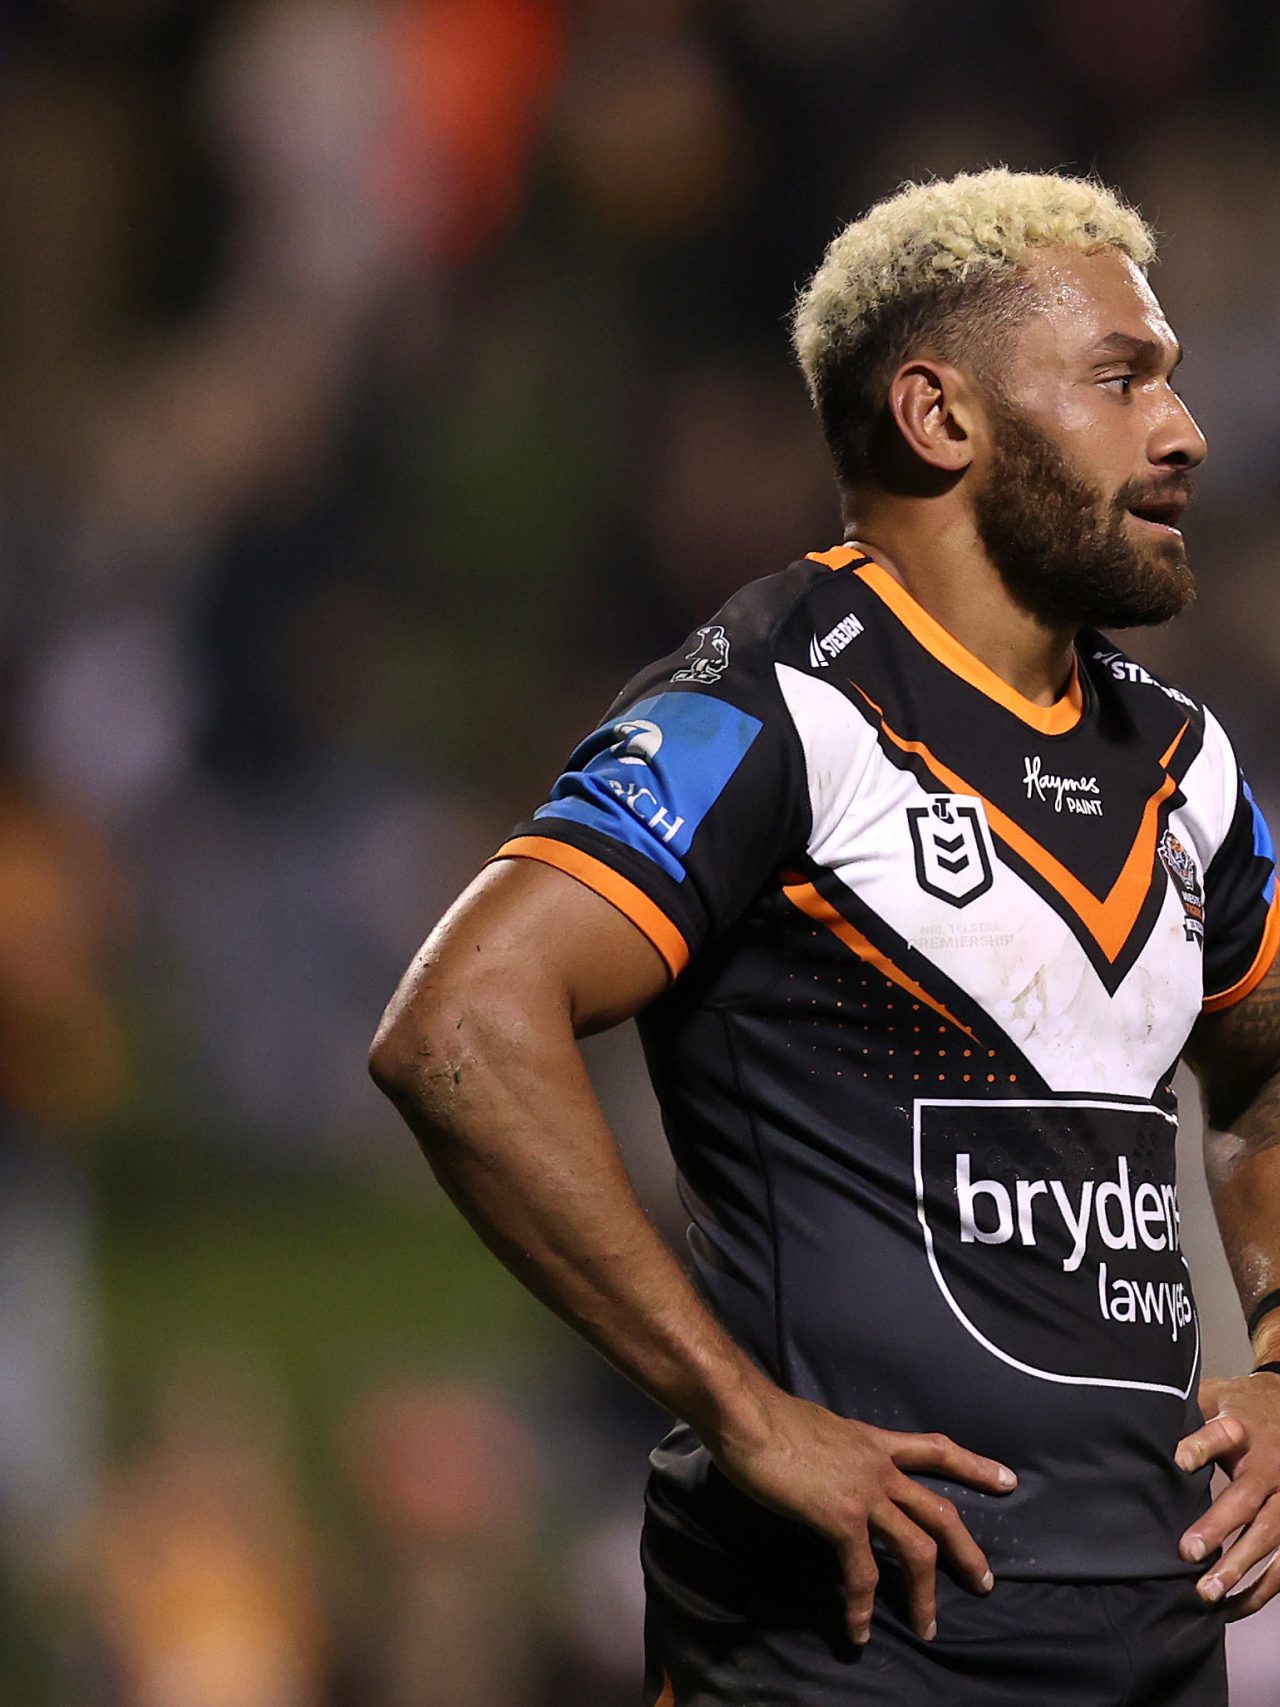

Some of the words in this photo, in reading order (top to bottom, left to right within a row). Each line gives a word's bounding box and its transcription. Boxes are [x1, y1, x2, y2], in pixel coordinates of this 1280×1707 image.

[1022, 755, 1100, 813] Haymes
[1065, 796, 1103, 817] PAINT
[955, 1153, 1181, 1272] bryden
